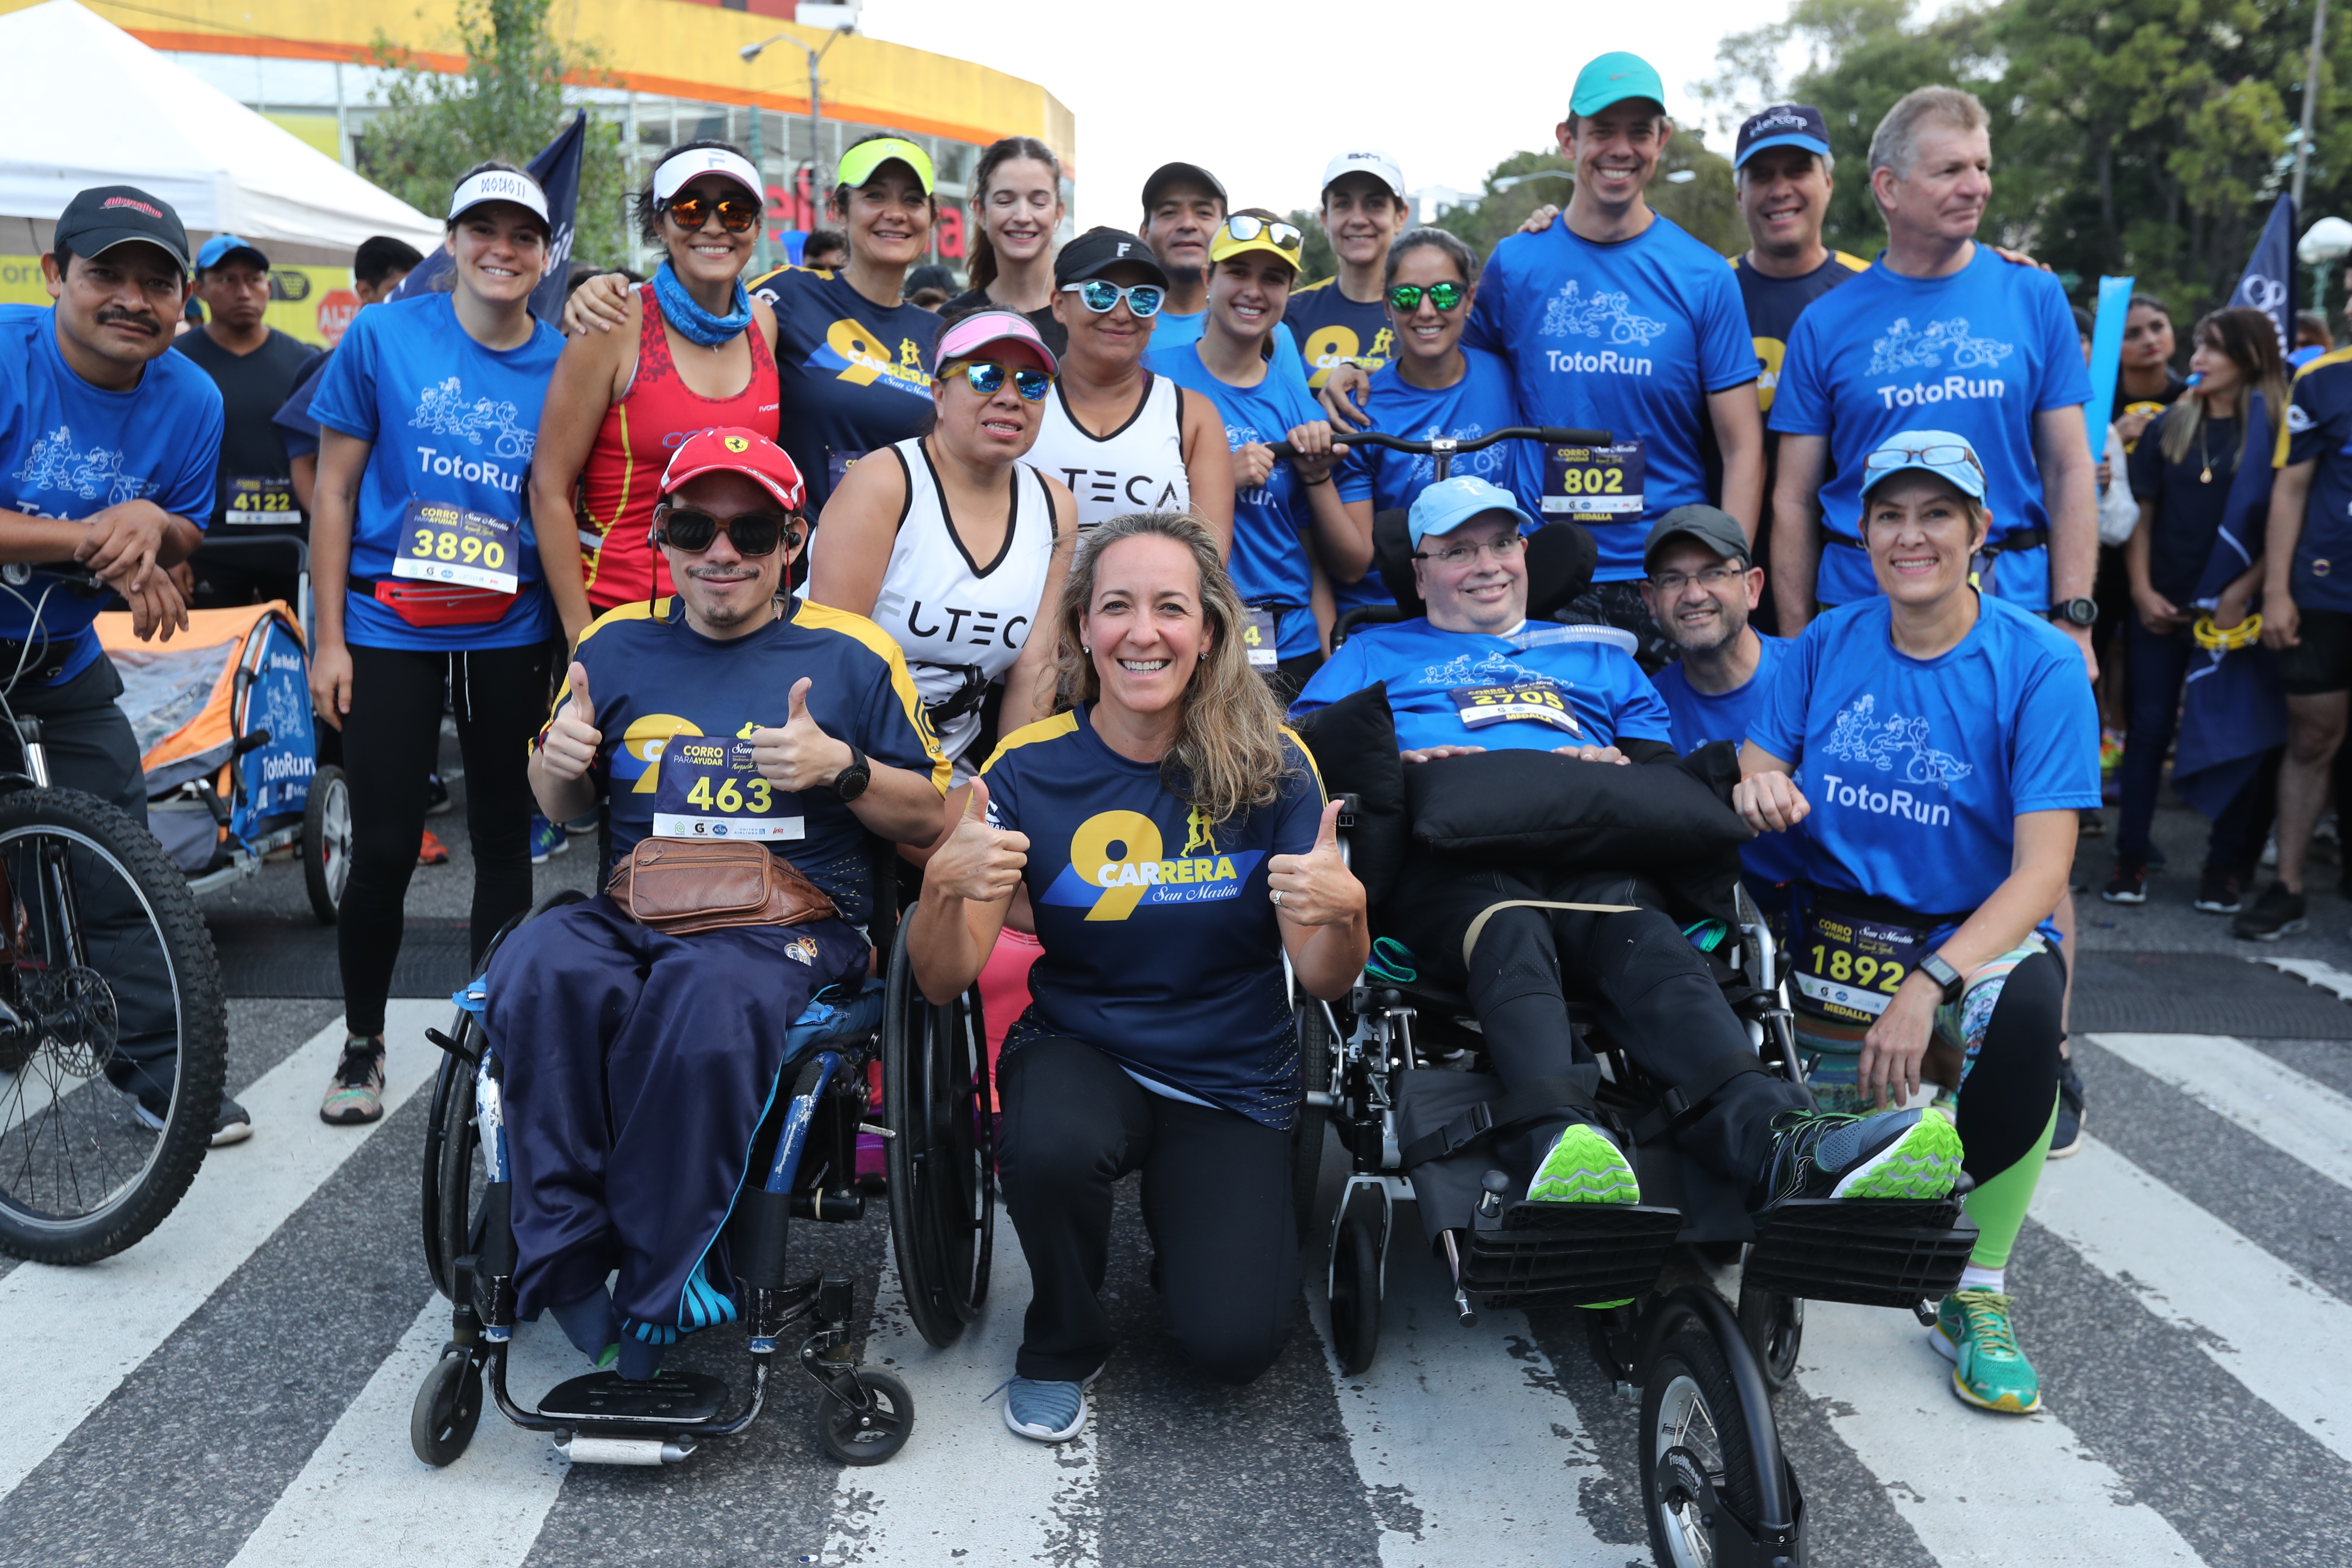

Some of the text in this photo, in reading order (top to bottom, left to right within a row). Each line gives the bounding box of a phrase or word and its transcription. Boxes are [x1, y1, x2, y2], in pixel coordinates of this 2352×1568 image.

[1117, 242, 1131, 257] F
[1007, 321, 1021, 333] F
[1546, 350, 1652, 377] TotoRun
[1877, 375, 2005, 410] TotoRun
[1564, 468, 1623, 494] 802
[233, 493, 290, 511] 4122
[421, 507, 458, 519] CORRO
[1573, 513, 1613, 521] MEDALLA
[412, 529, 505, 569] 3890
[1471, 691, 1565, 710] 2705
[1505, 713, 1553, 724] MEDALLA
[683, 745, 724, 758] CORRO
[262, 750, 316, 782] TotoRun
[687, 776, 772, 814] 463
[1823, 774, 1950, 827] TotoRun
[1097, 856, 1237, 888] CARRERA
[1152, 884, 1238, 902] San Martín
[1819, 919, 1852, 937] CORRO
[1812, 945, 1905, 993] 1892
[1823, 1001, 1872, 1022] MEDALLA
